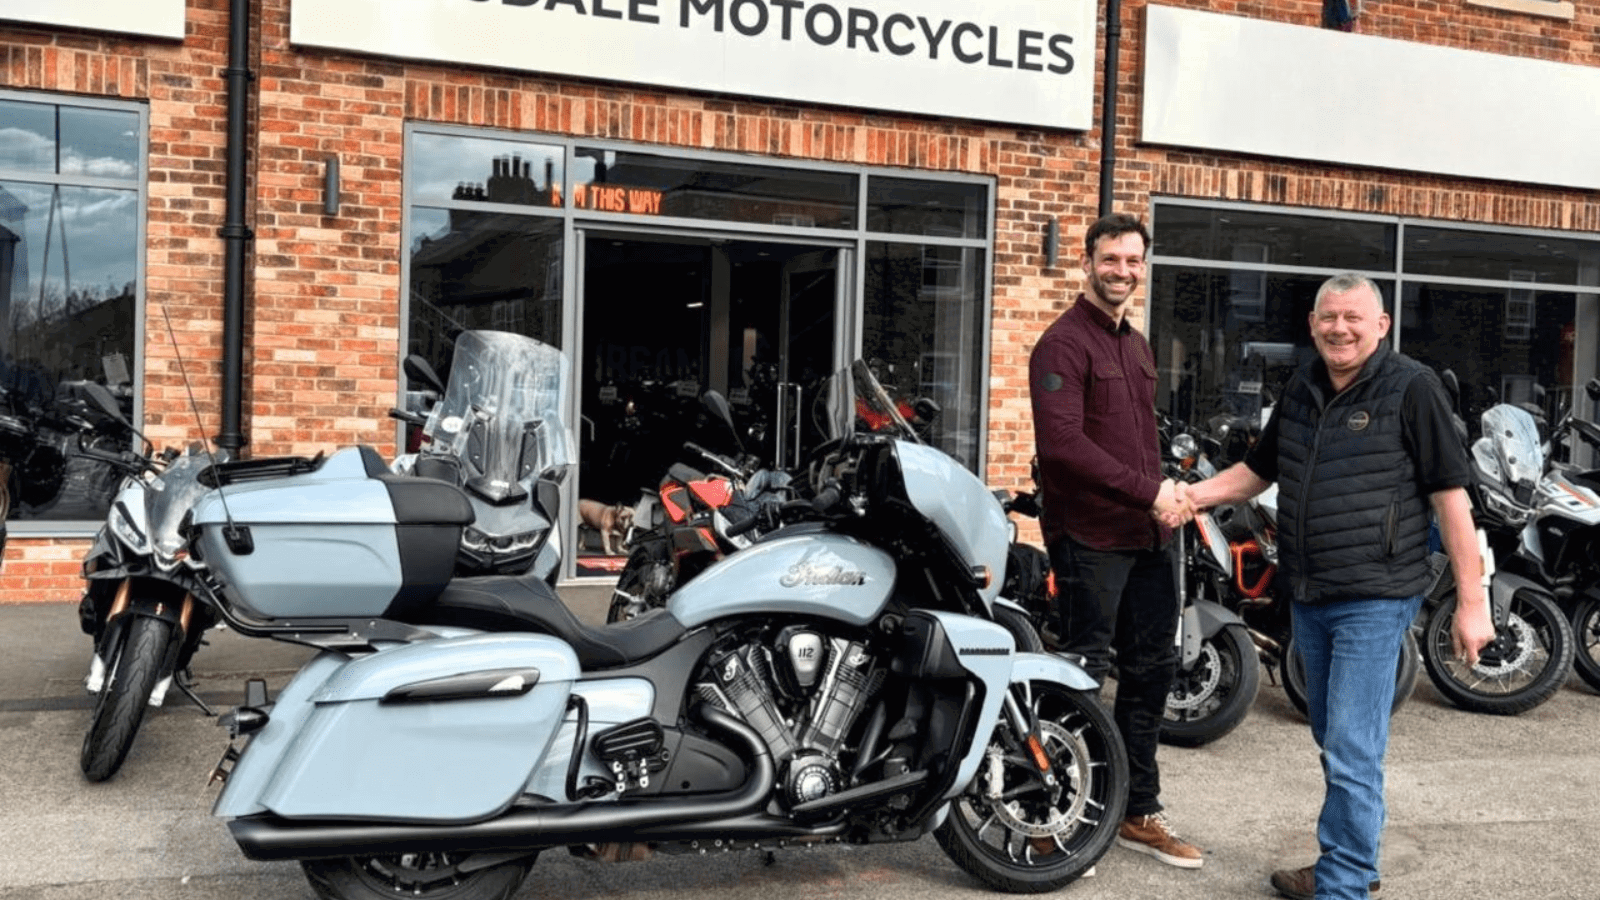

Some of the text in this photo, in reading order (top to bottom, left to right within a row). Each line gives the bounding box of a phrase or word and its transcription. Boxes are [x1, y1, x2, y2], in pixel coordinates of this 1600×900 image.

[680, 0, 1074, 75] MOTORCYCLES
[551, 184, 662, 214] KM THIS WAY
[798, 647, 815, 658] 112
